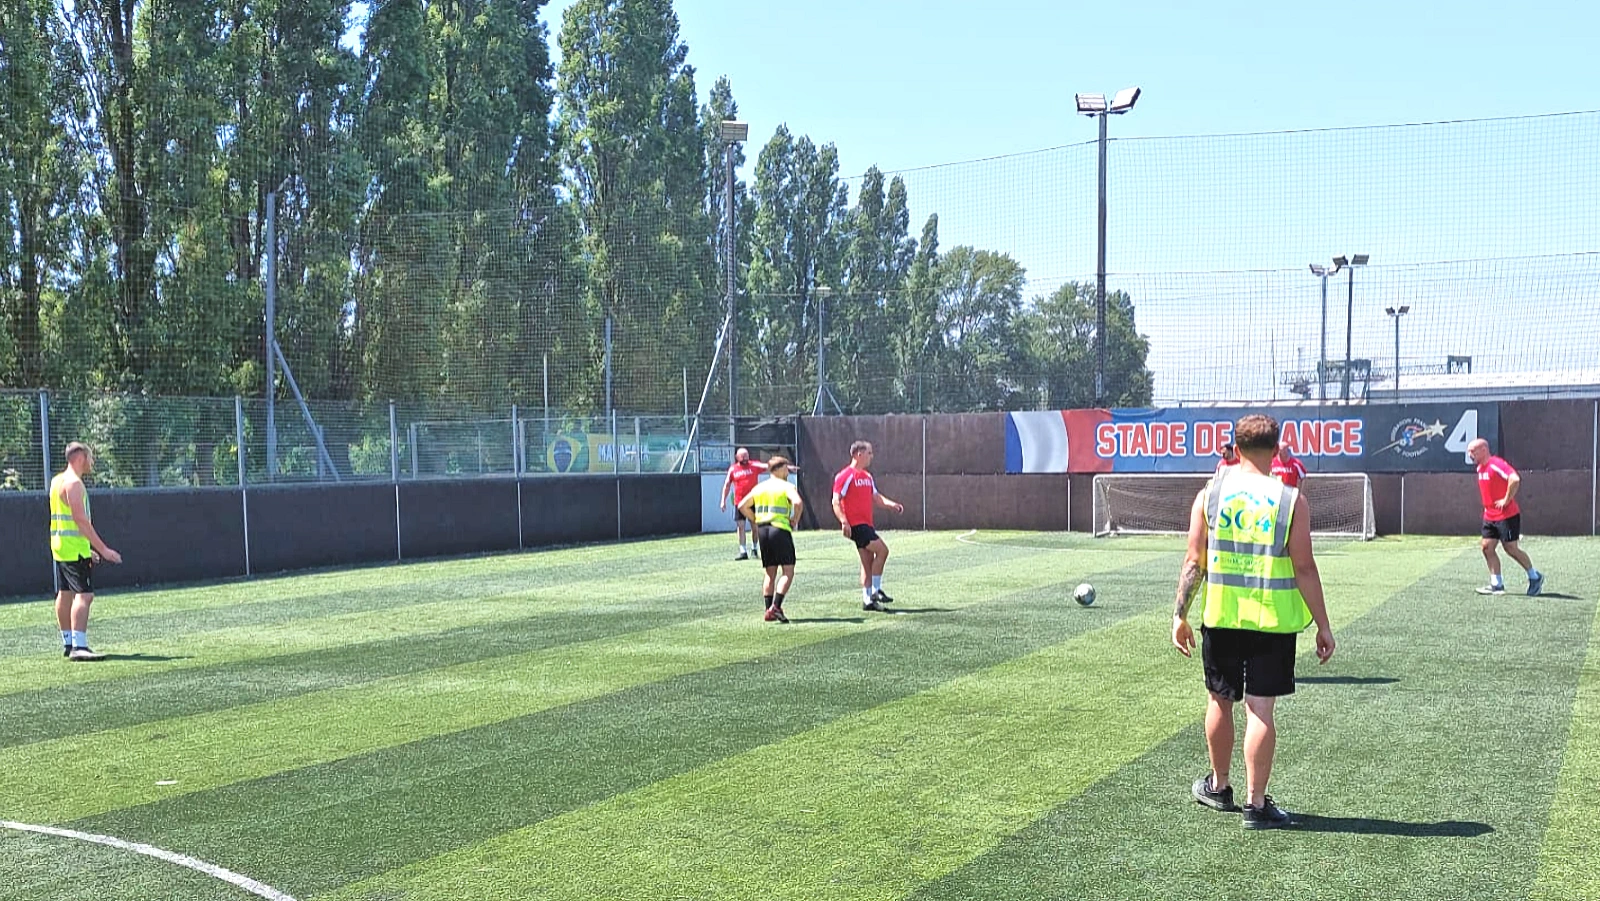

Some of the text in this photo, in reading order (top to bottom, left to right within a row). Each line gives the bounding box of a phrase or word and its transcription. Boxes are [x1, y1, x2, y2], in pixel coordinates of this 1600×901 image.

[1097, 419, 1363, 457] STADE DE ANCE
[1444, 409, 1478, 465] 4
